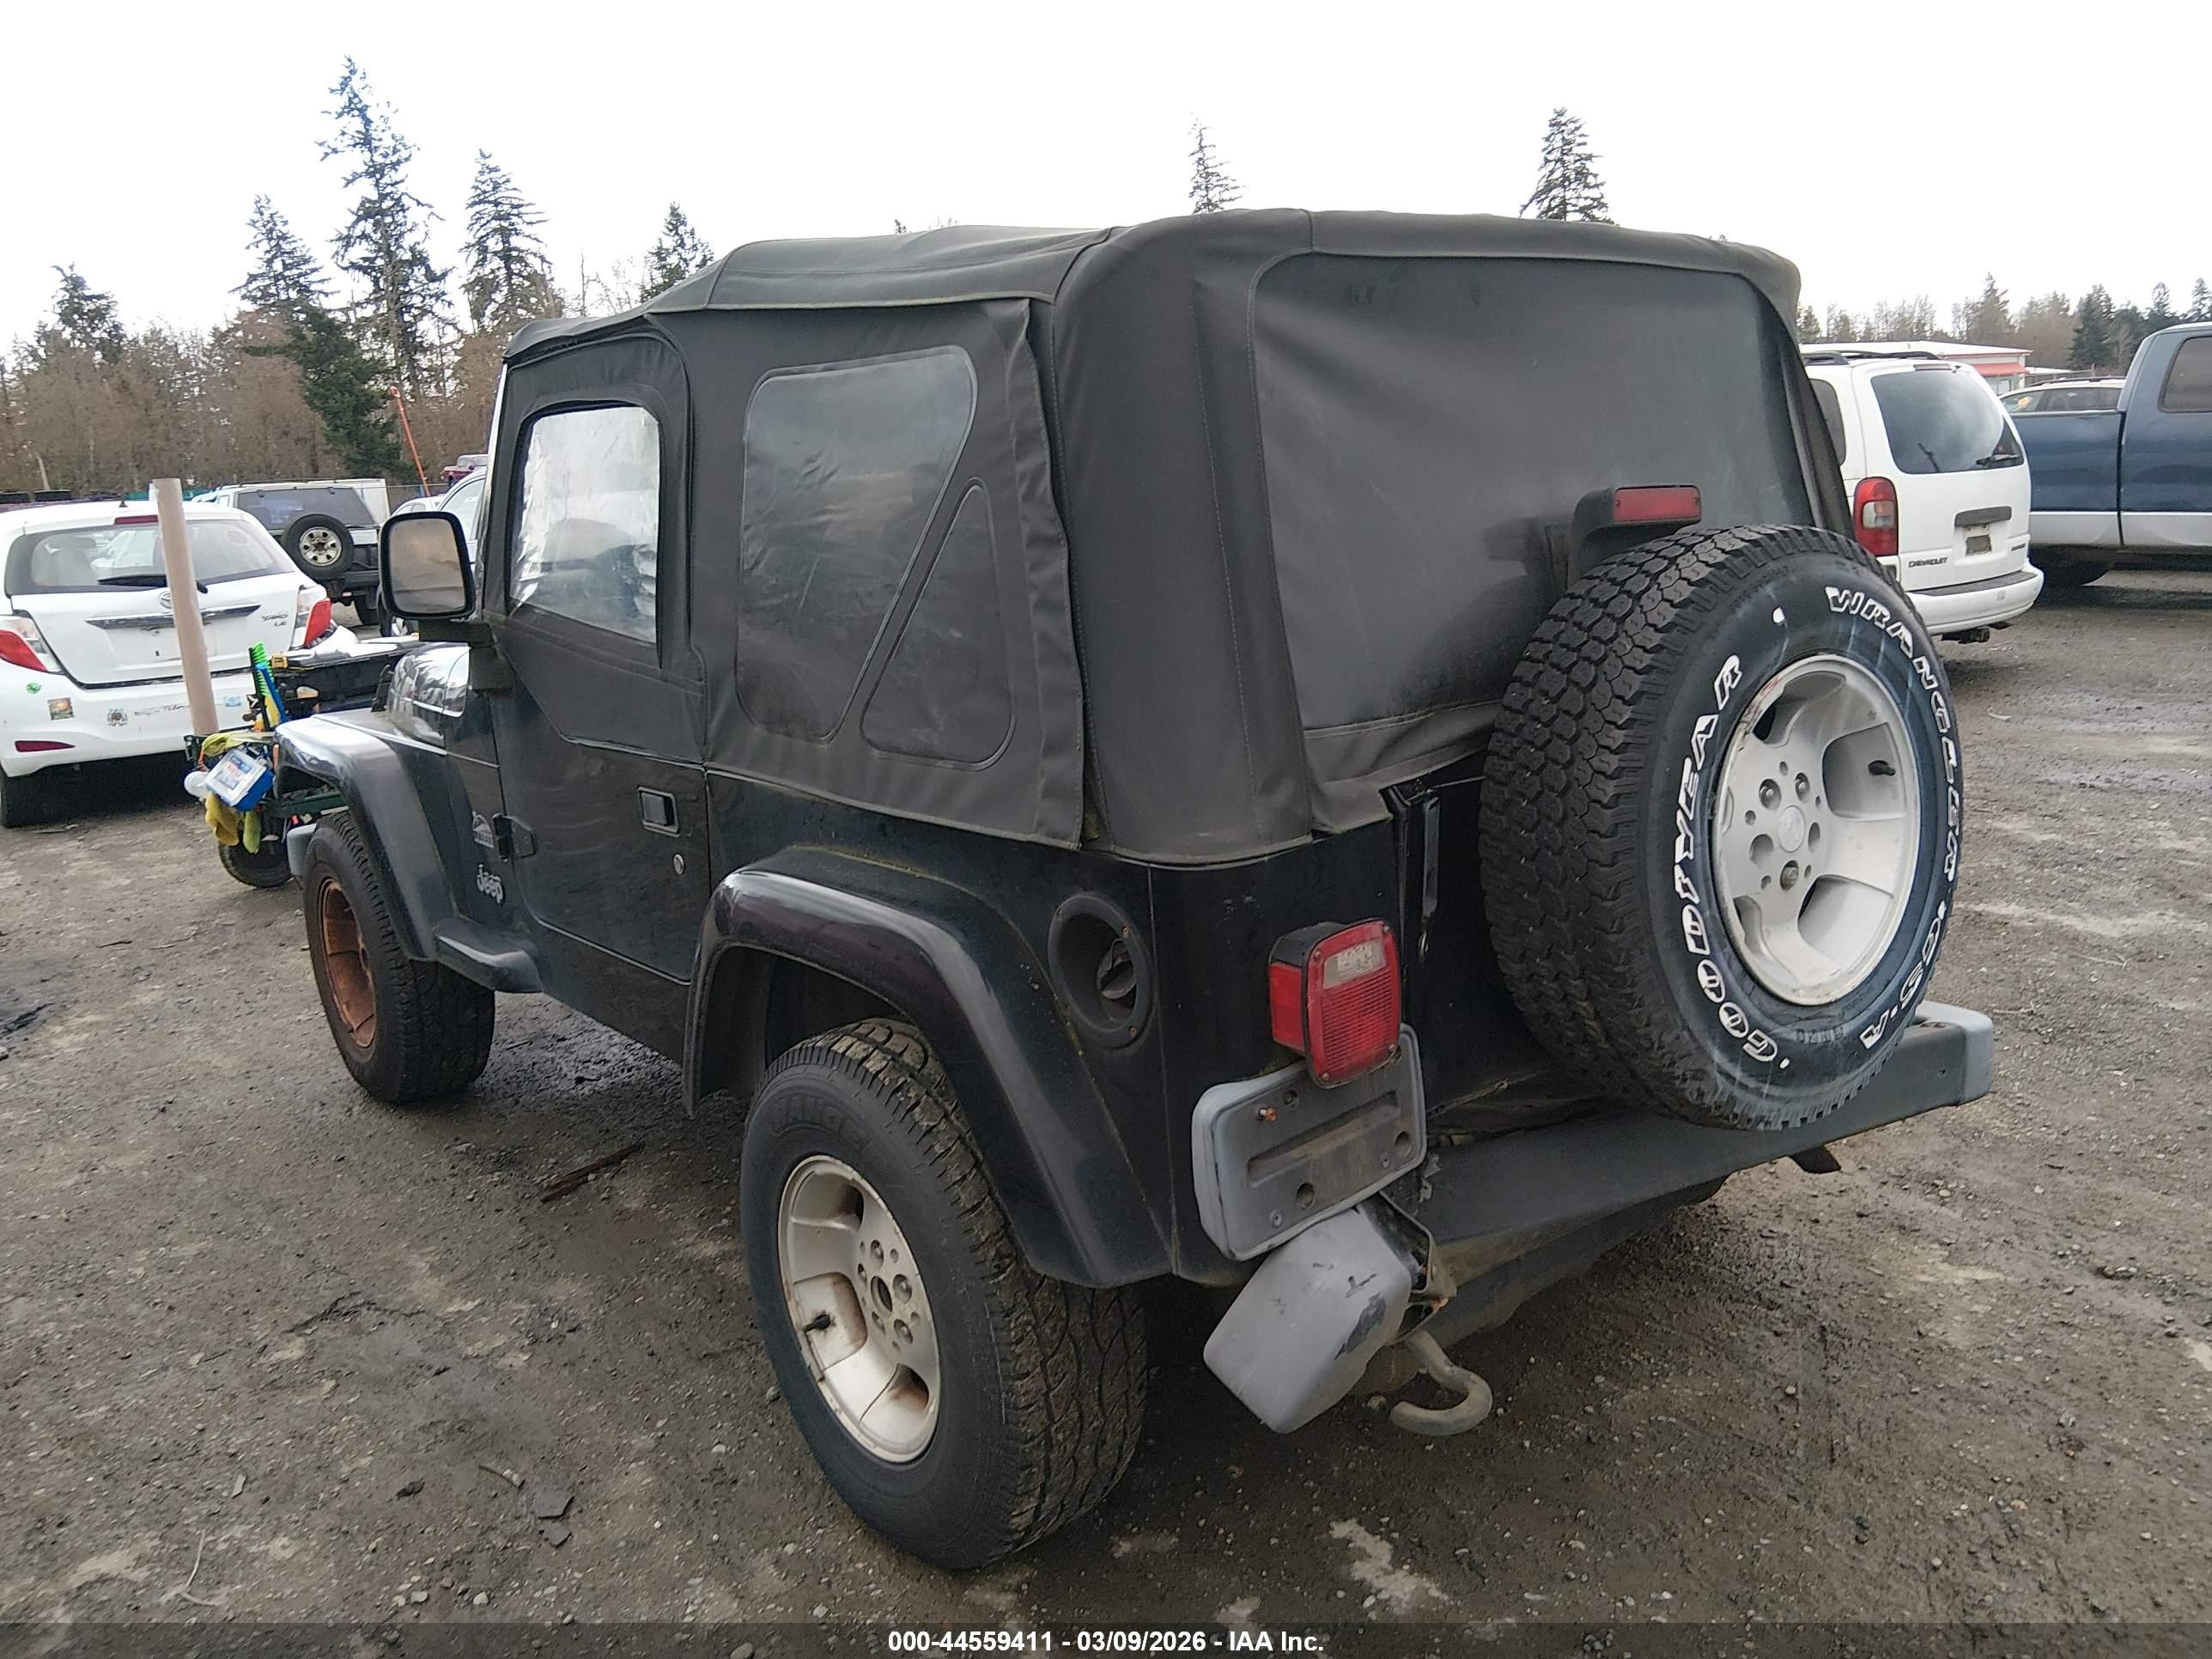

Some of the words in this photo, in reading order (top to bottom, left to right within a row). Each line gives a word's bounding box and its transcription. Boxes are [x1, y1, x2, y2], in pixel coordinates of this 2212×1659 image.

[1674, 654, 1778, 1062] GOODYEAR
[1825, 586, 1960, 882] WRANGLER
[477, 864, 503, 903] Jeep
